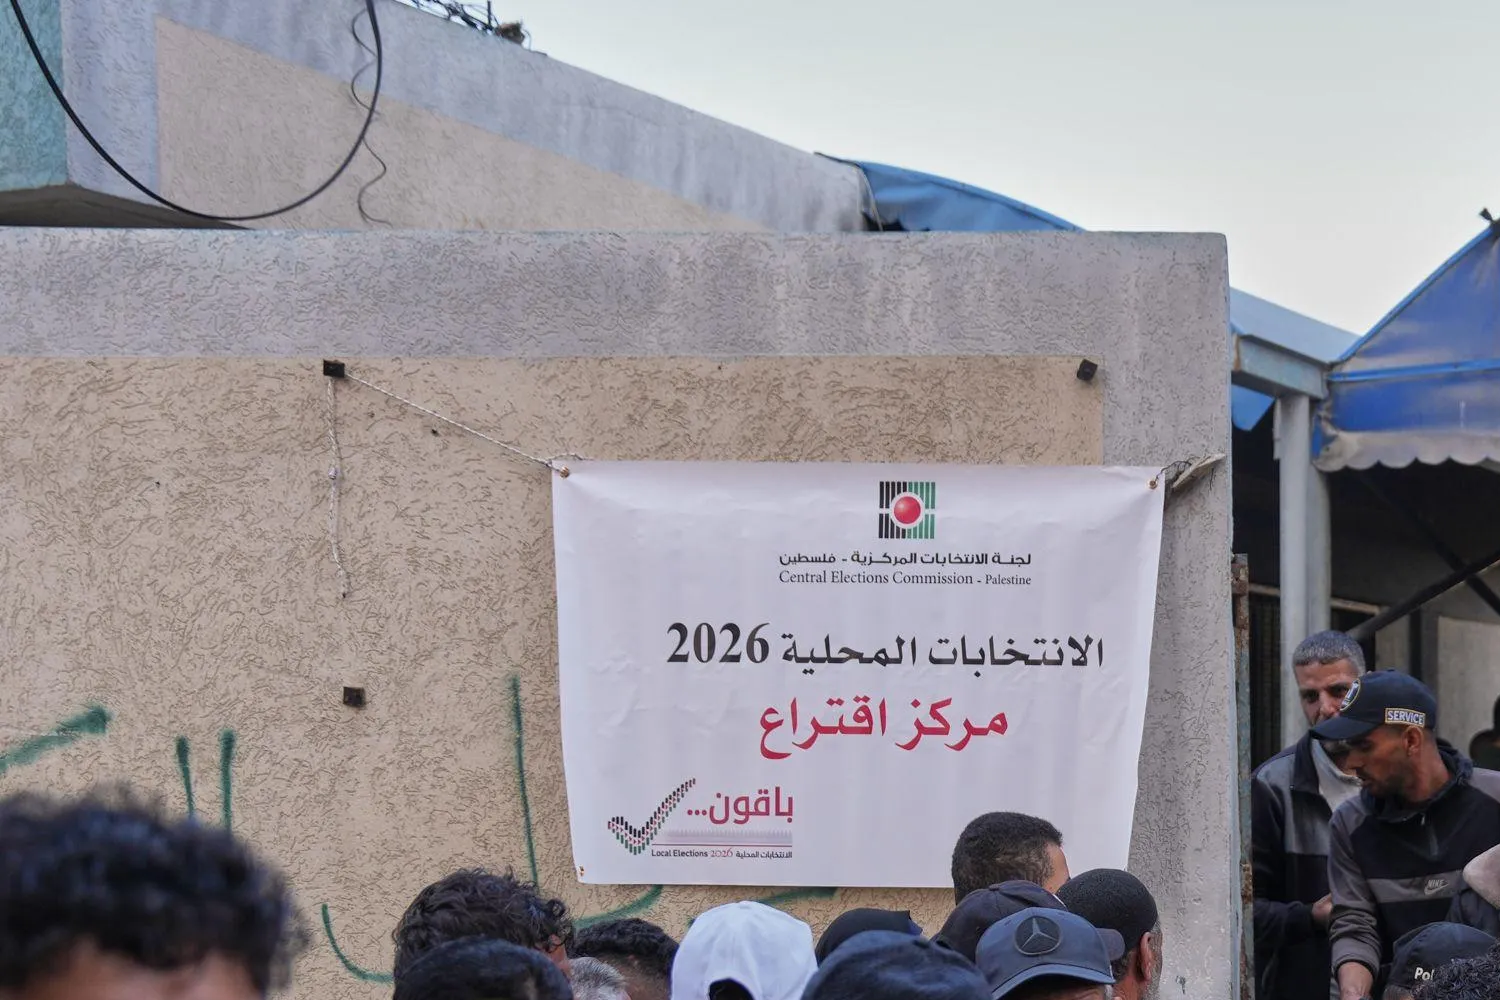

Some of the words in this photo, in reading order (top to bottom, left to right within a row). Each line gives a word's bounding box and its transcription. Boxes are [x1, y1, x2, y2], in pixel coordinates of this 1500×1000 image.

[779, 553, 837, 566] فلسطين
[851, 550, 918, 566] المركزية
[920, 552, 989, 567] الانتخابات
[991, 552, 1031, 567] لجنة
[779, 570, 827, 584] Central
[831, 570, 890, 584] Elections
[892, 571, 974, 585] Commission
[984, 573, 1032, 586] Palestine
[666, 621, 771, 664] 2026
[780, 632, 917, 675] المحلية
[928, 633, 1104, 678] الانتخابات
[894, 697, 1008, 751] مركز
[1387, 710, 1425, 725] SERVICE
[759, 695, 887, 760] اقتراع
[651, 849, 672, 858] Local
[673, 849, 709, 858] Elections
[710, 847, 734, 858] 2026
[735, 851, 760, 859] المحلية
[760, 851, 793, 860] الانتخابات
[1414, 966, 1435, 981] Pol
